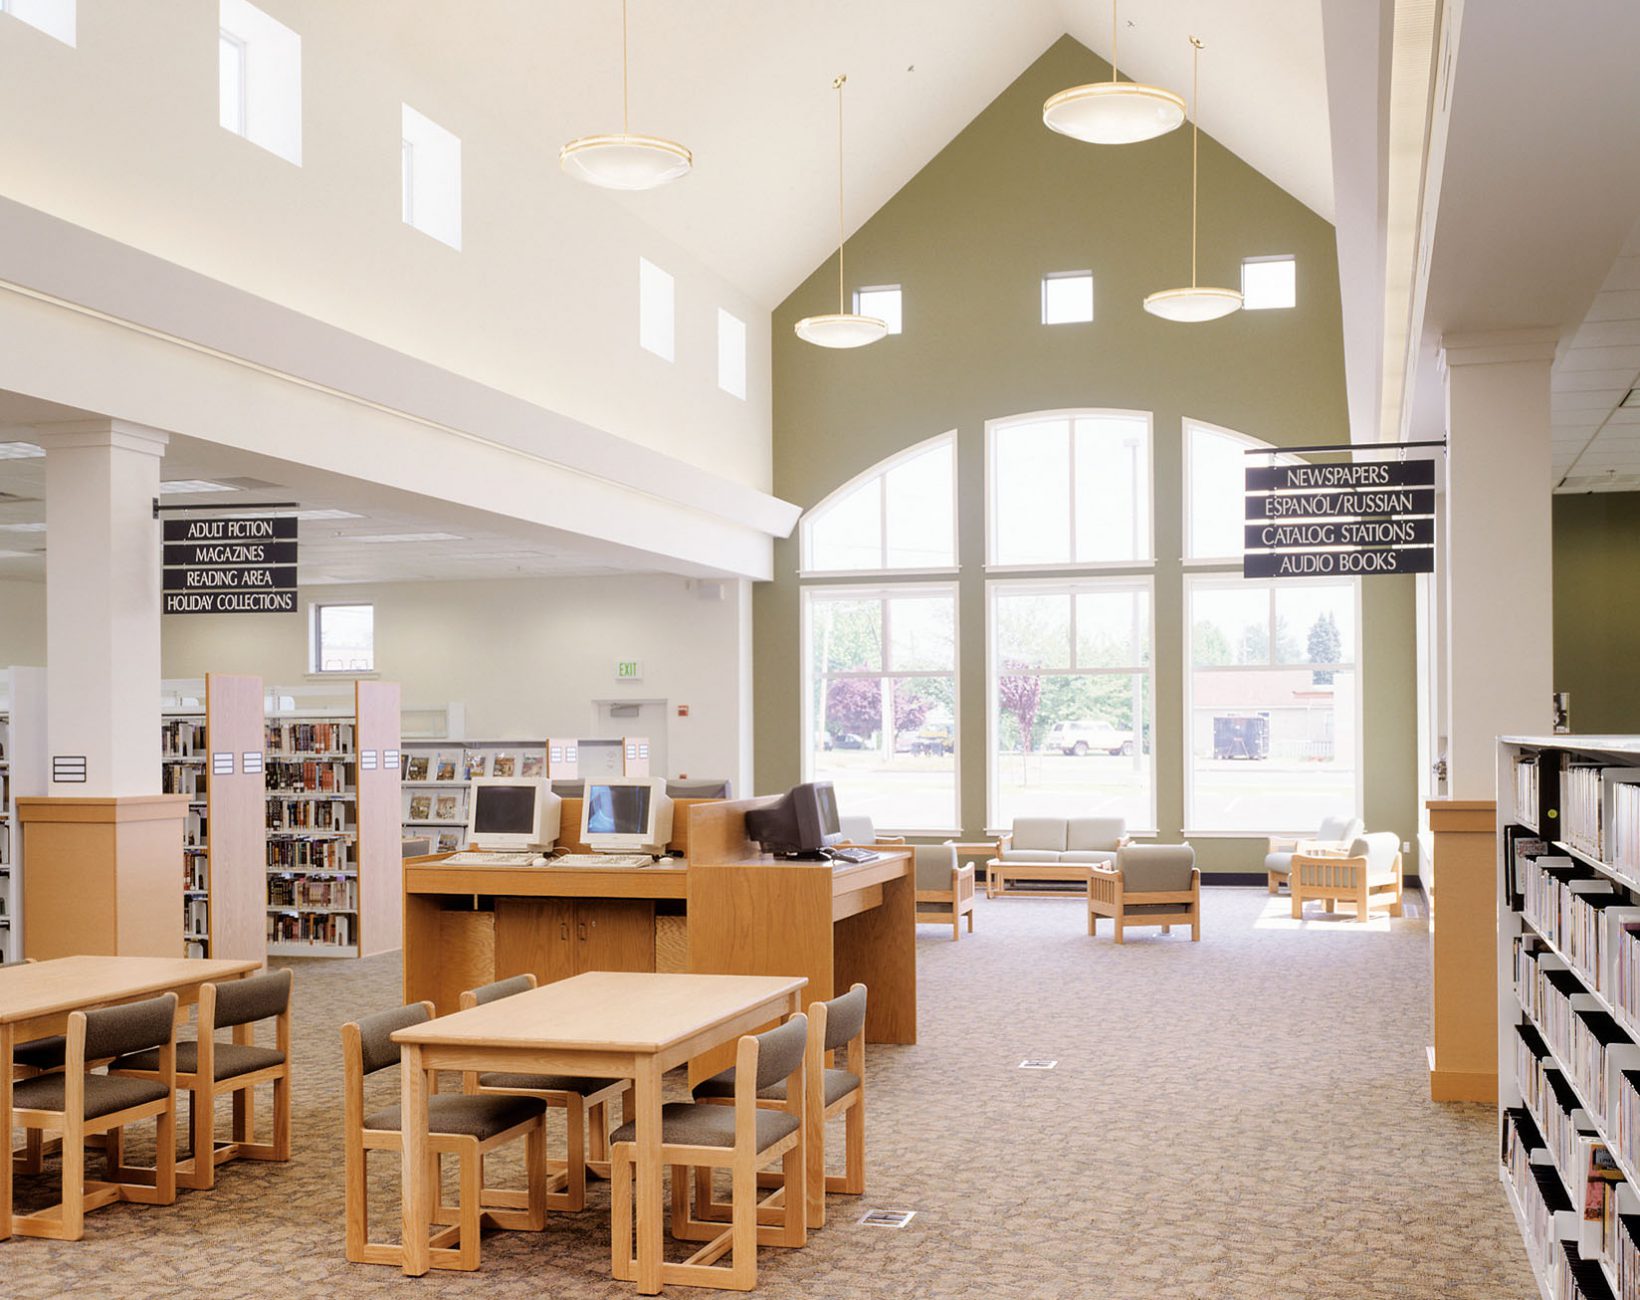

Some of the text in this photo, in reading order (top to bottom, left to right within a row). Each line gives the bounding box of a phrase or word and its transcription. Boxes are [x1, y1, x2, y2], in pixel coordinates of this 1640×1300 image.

[1287, 465, 1389, 487] NEWSPAPERS
[187, 520, 273, 538] ADULT FICTION
[1261, 522, 1415, 545] CATALOG STATIONS
[195, 545, 265, 562] MAGAZINES
[1279, 552, 1397, 573] AUDIO BOOKS
[186, 570, 272, 587] READING AREA
[167, 594, 292, 611] HOLIDAY COLLECTIONS
[619, 662, 637, 677] EXIT
